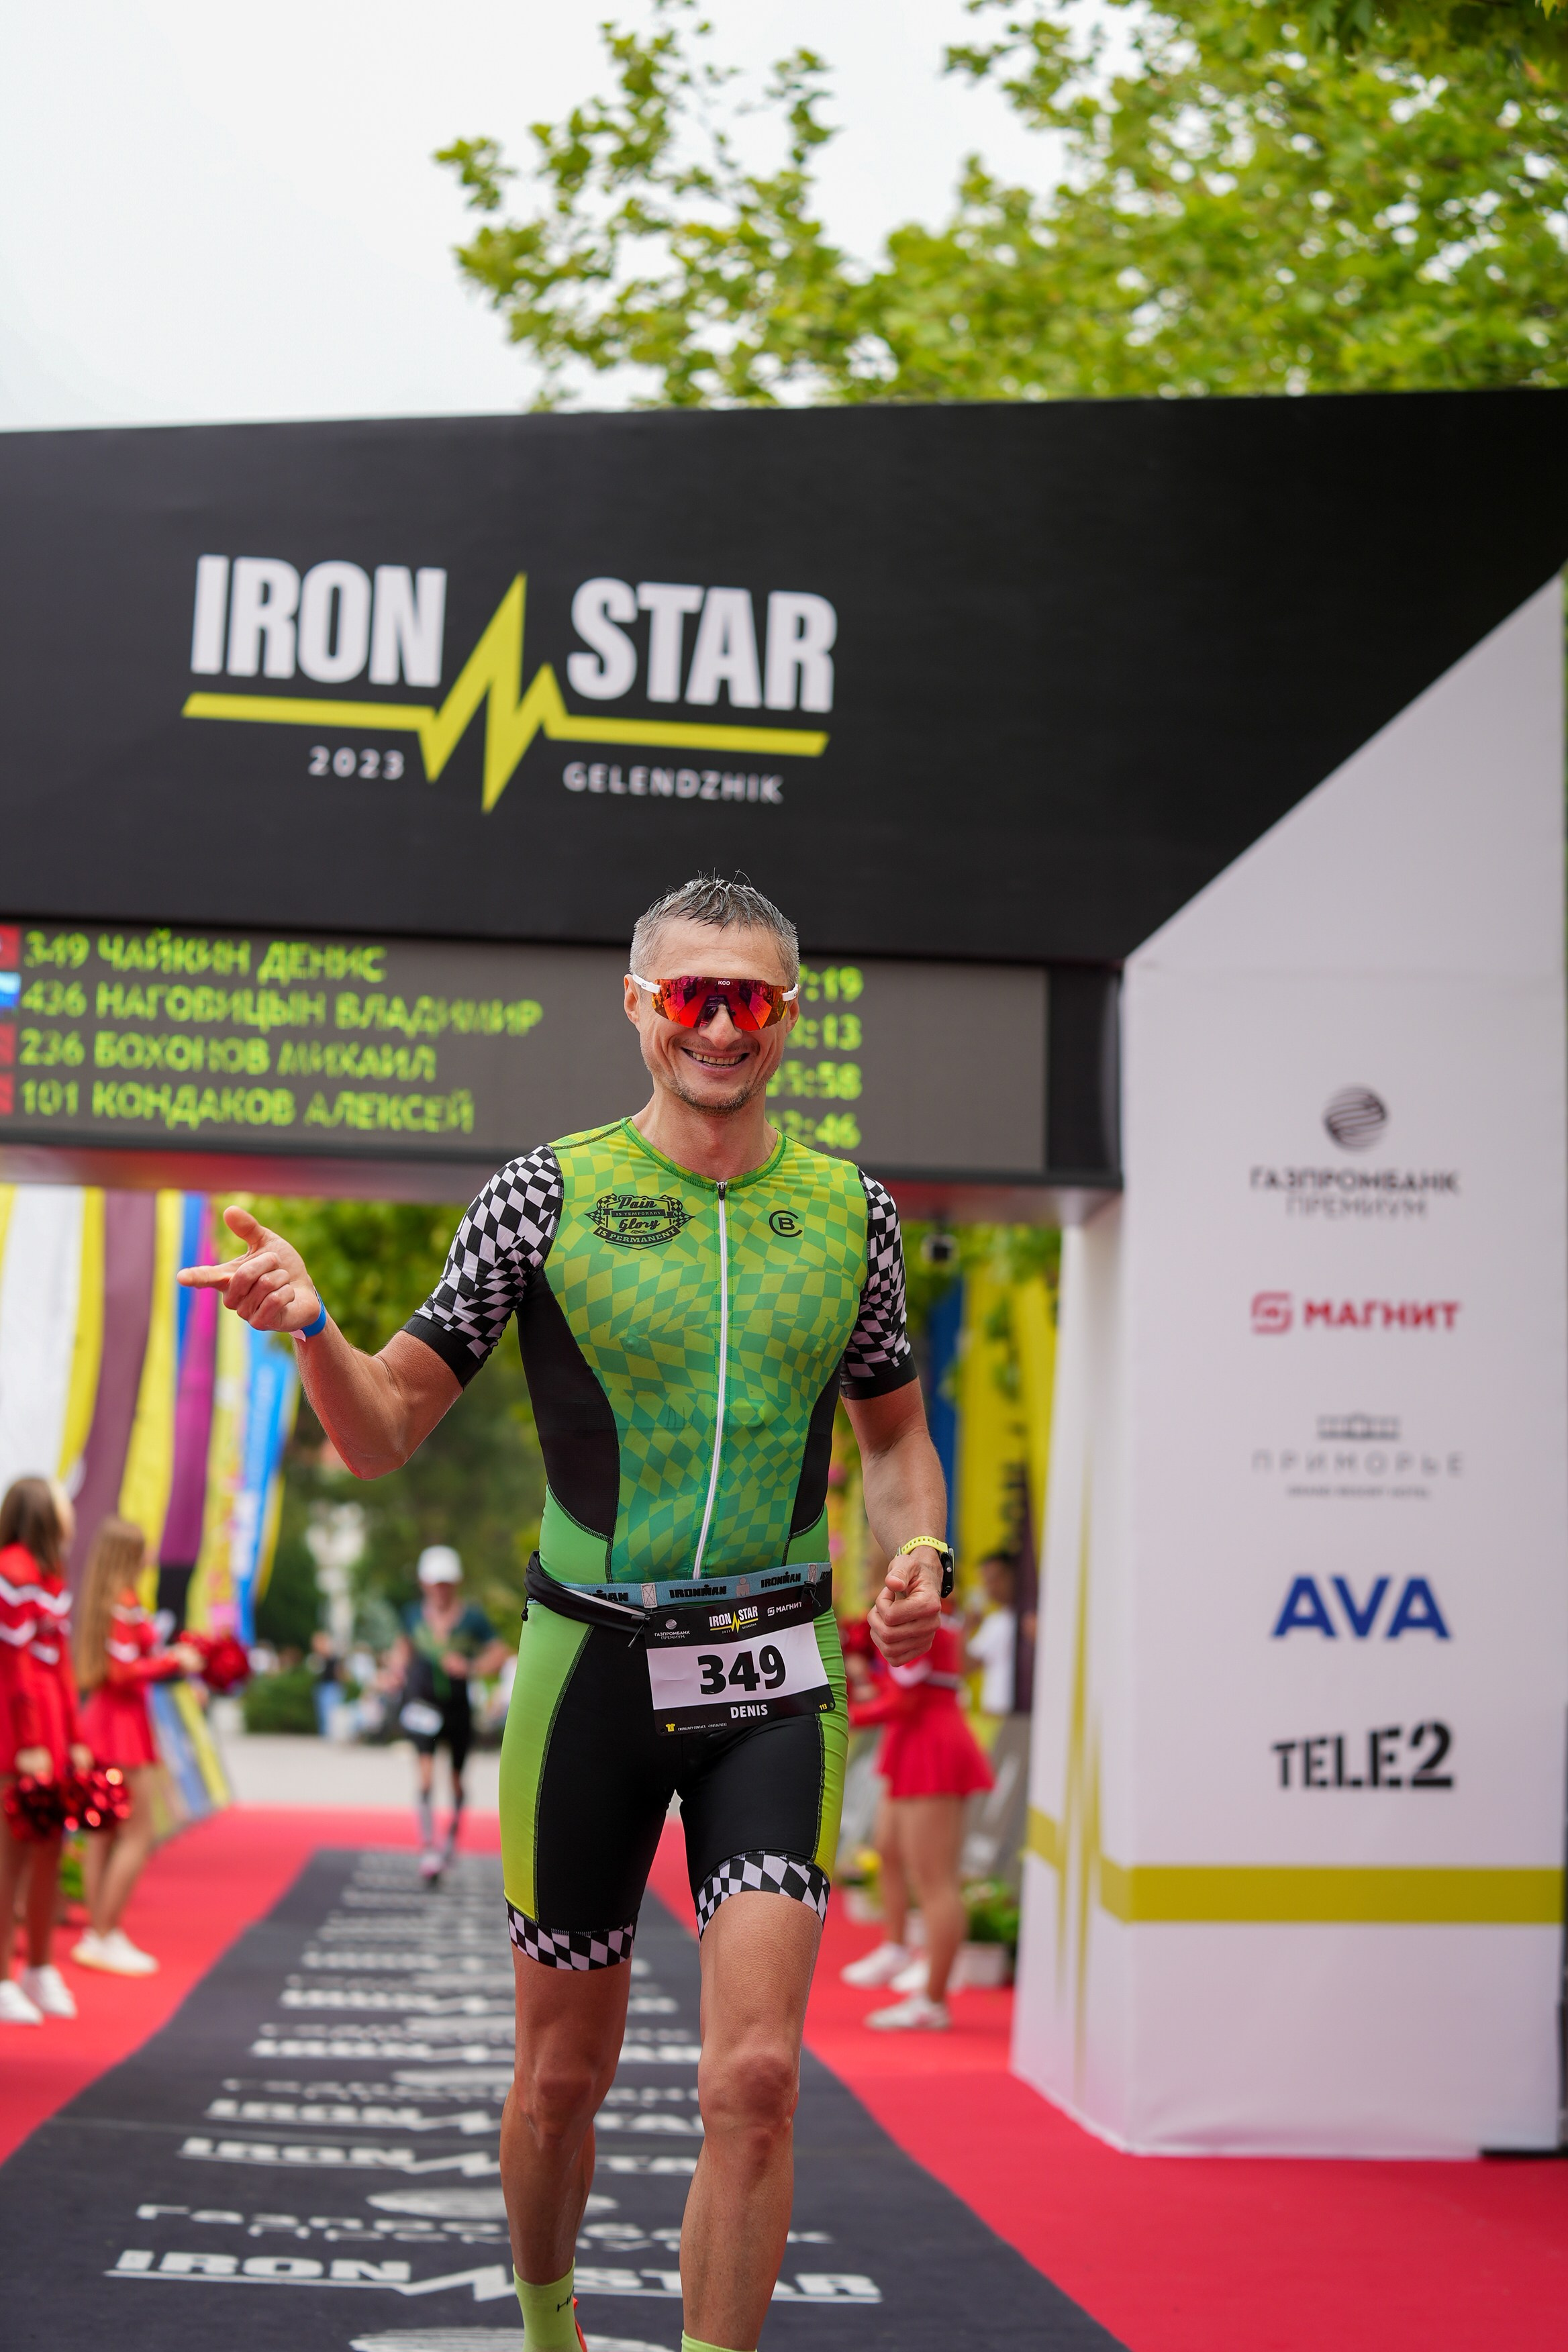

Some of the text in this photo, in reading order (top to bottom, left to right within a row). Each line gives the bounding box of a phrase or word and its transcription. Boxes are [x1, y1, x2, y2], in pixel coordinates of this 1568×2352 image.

[190, 554, 838, 713] IRON STAR
[308, 745, 783, 804] 2023 GELENDZHIK
[24, 927, 864, 1003] 349 ЧАЙКИН ДЕНИС :19
[21, 979, 87, 1018] 436
[96, 981, 326, 1033] НАГОВИЦЫН
[336, 991, 543, 1039] ВЛАДИМИР
[19, 1028, 85, 1067] 236
[93, 1030, 269, 1075] БОХОНОВ
[277, 1040, 436, 1083] МИХАИЛ
[20, 1079, 79, 1116] 101
[92, 1079, 296, 1131] КОНДАКОВ
[303, 1087, 475, 1134] АЛЕКСЕЙ
[1250, 1167, 1461, 1194] ГАЗПРОМБАНК
[618, 1197, 657, 1209] Pain
[597, 1228, 676, 1242] IS PERMANENT
[619, 1218, 660, 1232] Glory
[1304, 1300, 1461, 1329] МАГНИТ
[1251, 1449, 1463, 1478] ПРИМОРЬЕ
[669, 1584, 727, 1598] IRONMAN
[761, 1571, 801, 1588] IRONMAN
[709, 1606, 758, 1628] IRON STAR
[776, 1602, 802, 1613] МАГНИТ
[1271, 1574, 1452, 1640] AVA
[697, 1645, 786, 1695] 349
[730, 1704, 769, 1719] DENIS
[1271, 1718, 1453, 1790] TELE2
[115, 2249, 411, 2282] IRON
